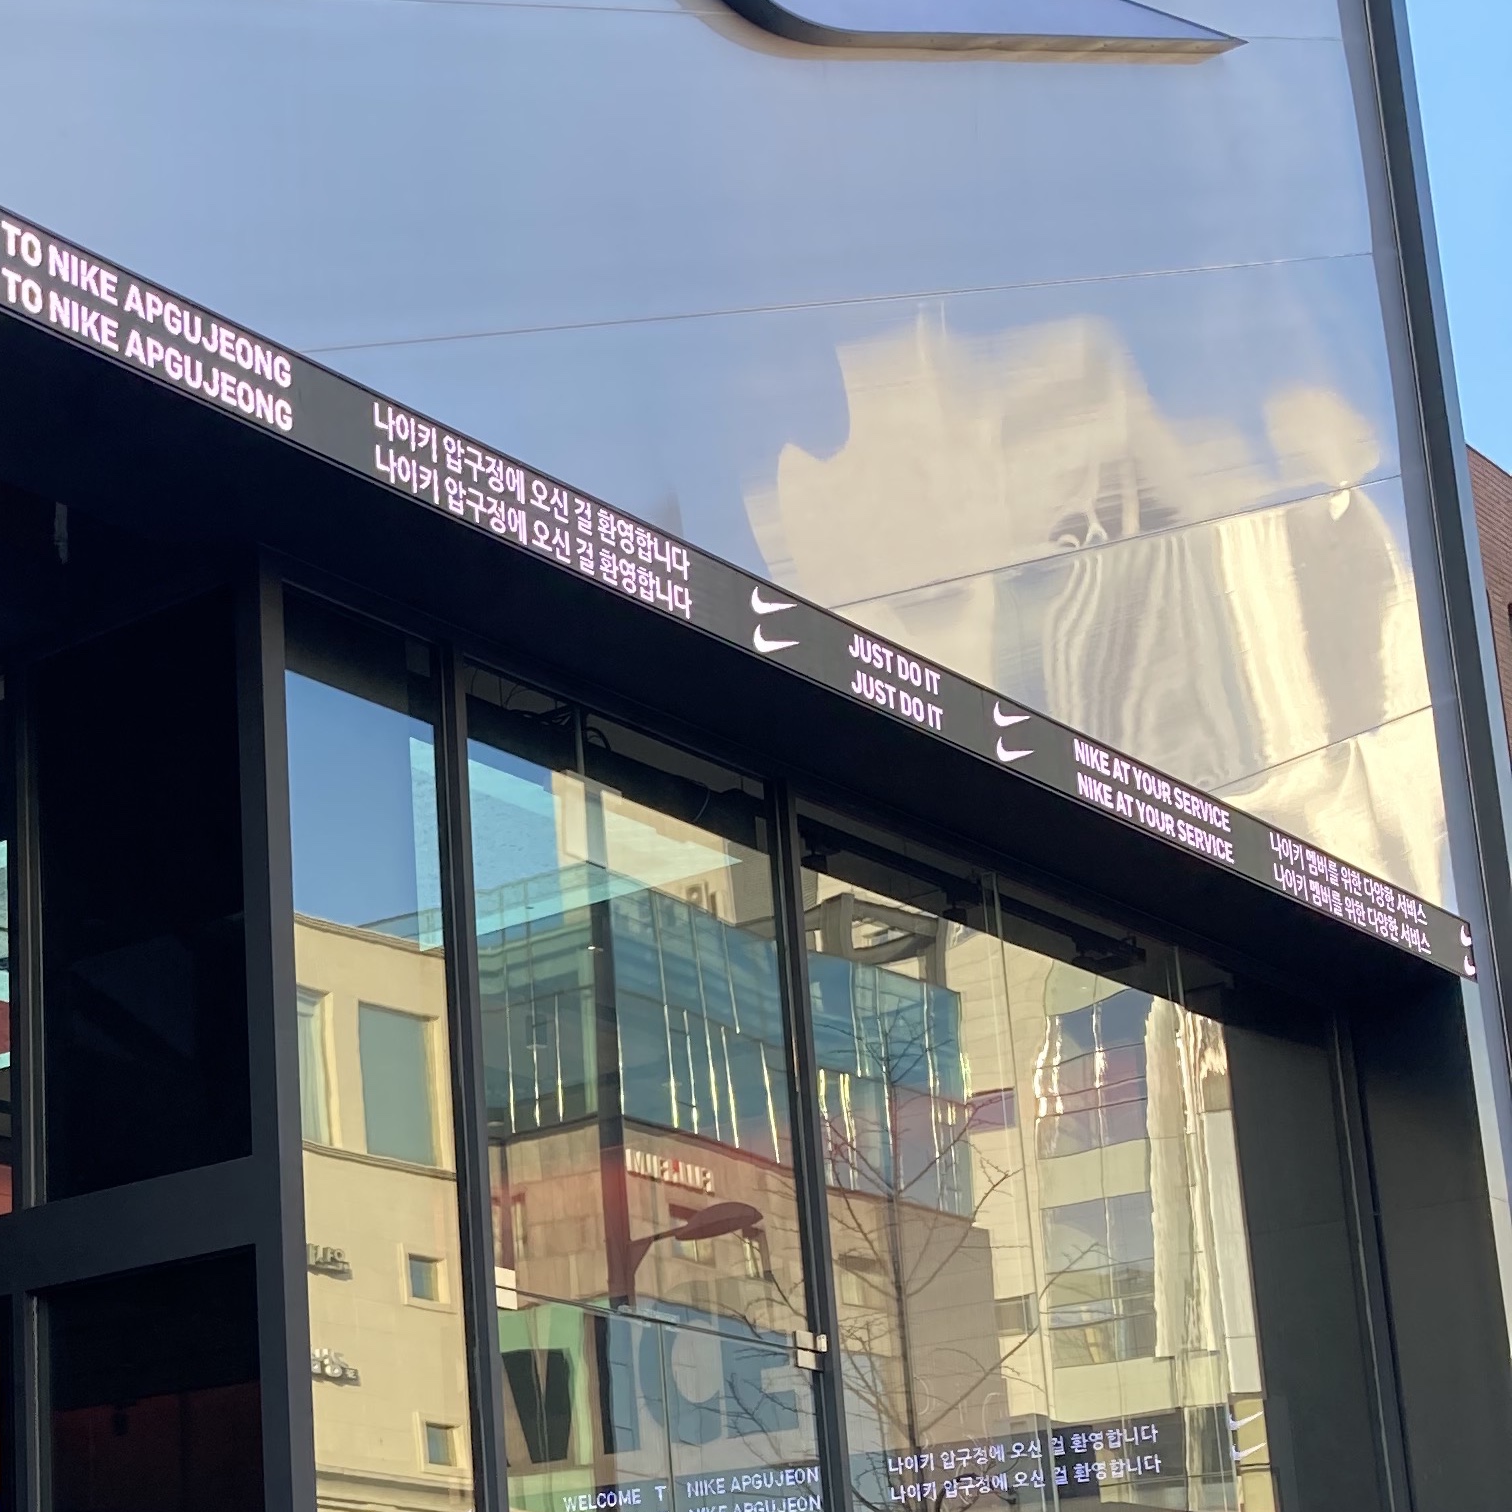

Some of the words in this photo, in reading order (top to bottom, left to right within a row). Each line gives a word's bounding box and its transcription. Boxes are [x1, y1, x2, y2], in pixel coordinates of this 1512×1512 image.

[1, 220, 42, 267] TO
[49, 244, 118, 306] NIKE
[124, 284, 291, 388] APGUJEONG
[1, 267, 42, 314] TO
[49, 290, 119, 351] NIKE
[125, 329, 293, 431] APGUJEONG
[374, 402, 437, 463] 나이키
[443, 435, 525, 504] 압구정에
[530, 480, 569, 524] 오신
[574, 498, 592, 536] 걸
[597, 508, 690, 581] 환영합니다
[375, 444, 439, 504] 나이키
[444, 477, 527, 545] 압구정에
[532, 520, 571, 564] 오신
[576, 537, 594, 576] 걸
[599, 549, 692, 619] 환영합니다
[849, 634, 893, 673] JUST
[897, 654, 922, 687] DO
[925, 667, 941, 695] IT
[851, 670, 896, 709] JUST
[900, 690, 924, 722] DO
[927, 703, 943, 730] IT
[1073, 738, 1110, 776] NIKE
[1113, 758, 1131, 785] AT
[1132, 766, 1172, 806] YOUR
[1173, 786, 1231, 832] SERVICE
[1077, 772, 1114, 809] NIKE
[1116, 791, 1134, 818] AT
[1136, 799, 1176, 838] YOUR
[1177, 819, 1234, 864] SERVICE
[1270, 832, 1304, 870] 나이키
[1306, 849, 1339, 887] 멤버를
[1341, 866, 1362, 897] 위한
[1363, 877, 1395, 912] 다양한
[1397, 893, 1427, 925] 서비스
[1273, 863, 1308, 901] 나이키
[1309, 879, 1343, 917] 멤버를
[1345, 897, 1366, 927] 위한
[1367, 907, 1398, 942] 다양한
[1401, 923, 1431, 955] 서비스
[562, 1488, 641, 1512] WELCOME
[655, 1485, 667, 1501] T
[687, 1477, 726, 1498] NIKE
[730, 1466, 819, 1493] APGUJEON
[888, 1452, 935, 1475] 나이키
[940, 1443, 1005, 1470] 압구정에
[1010, 1438, 1042, 1459] 오신
[1052, 1435, 1065, 1456] 걸
[1070, 1423, 1158, 1453] 환영합니다
[890, 1480, 937, 1503] 나이키
[943, 1472, 1008, 1498] 압구정에
[1013, 1467, 1045, 1488] 오신
[1054, 1465, 1068, 1485] 걸
[1073, 1453, 1161, 1483] 환영합니다
